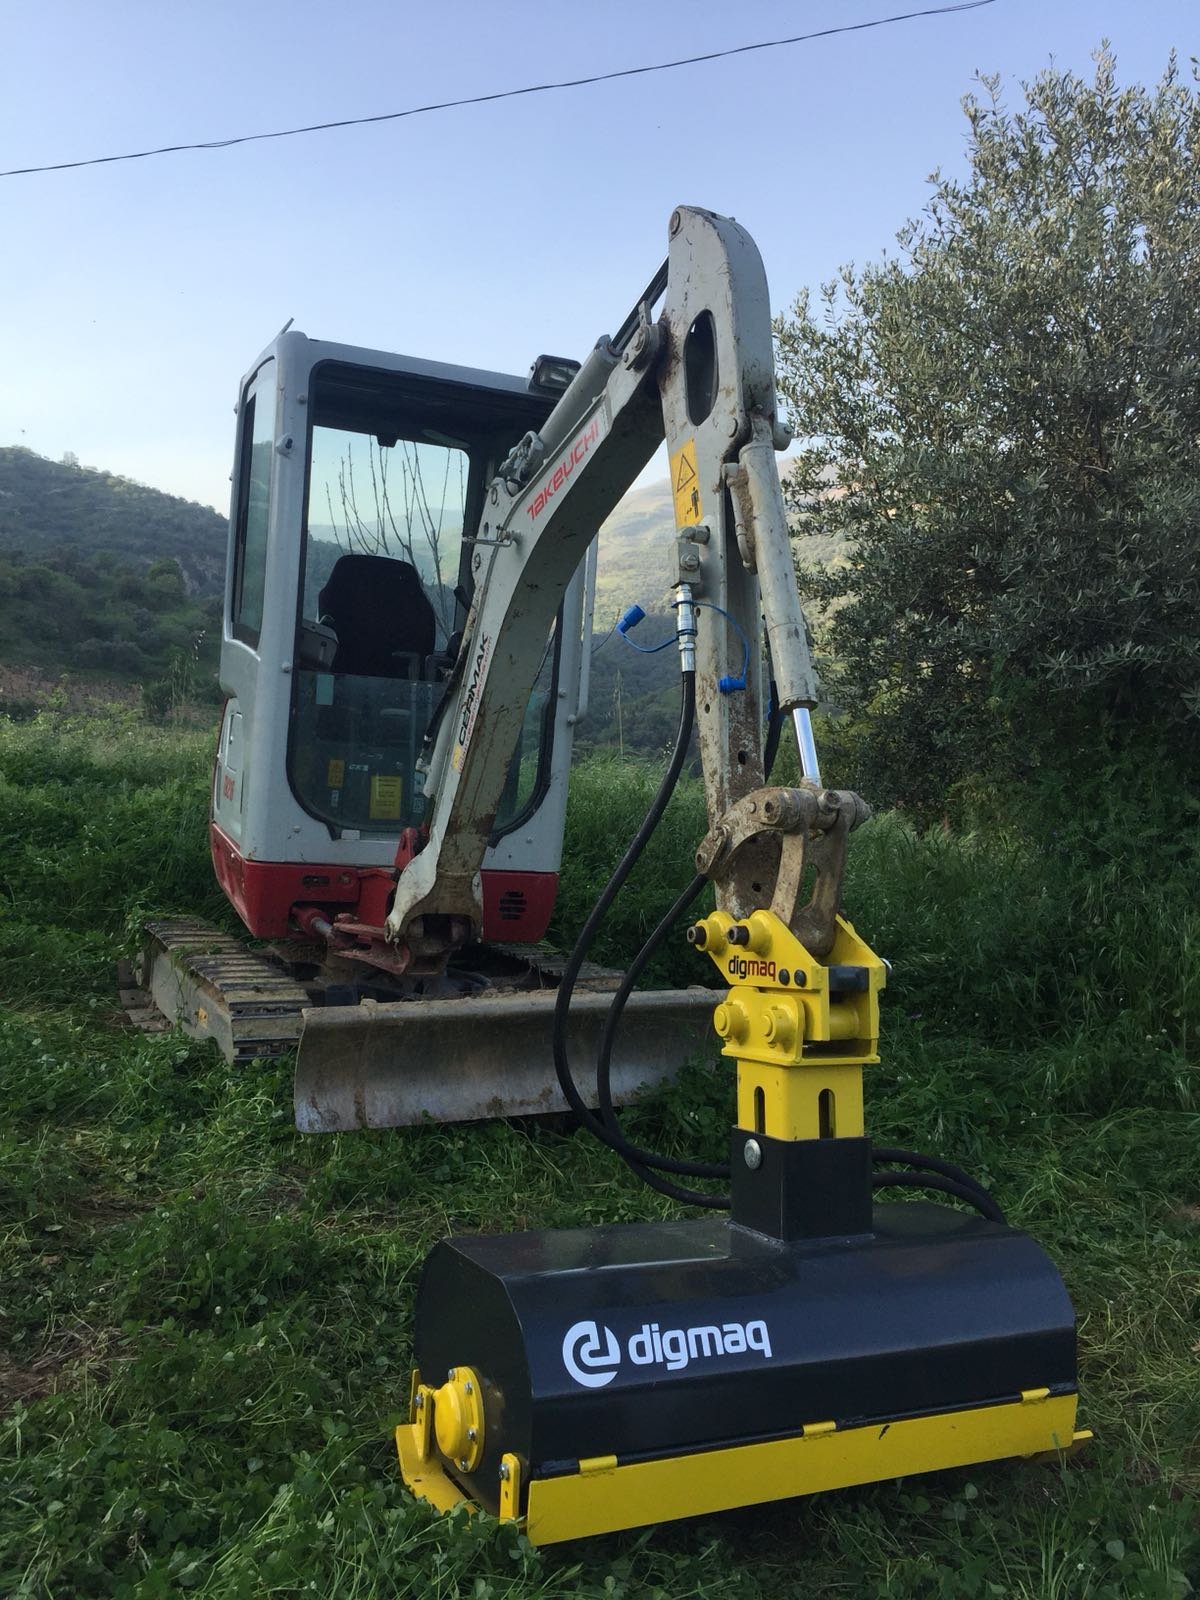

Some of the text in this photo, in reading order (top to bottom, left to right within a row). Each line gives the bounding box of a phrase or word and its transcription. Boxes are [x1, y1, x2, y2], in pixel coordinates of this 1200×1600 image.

[527, 419, 599, 520] TAKEUCHI
[459, 632, 489, 746] CERMAK
[728, 955, 776, 981] digmaq
[628, 1320, 772, 1371] digmaq
